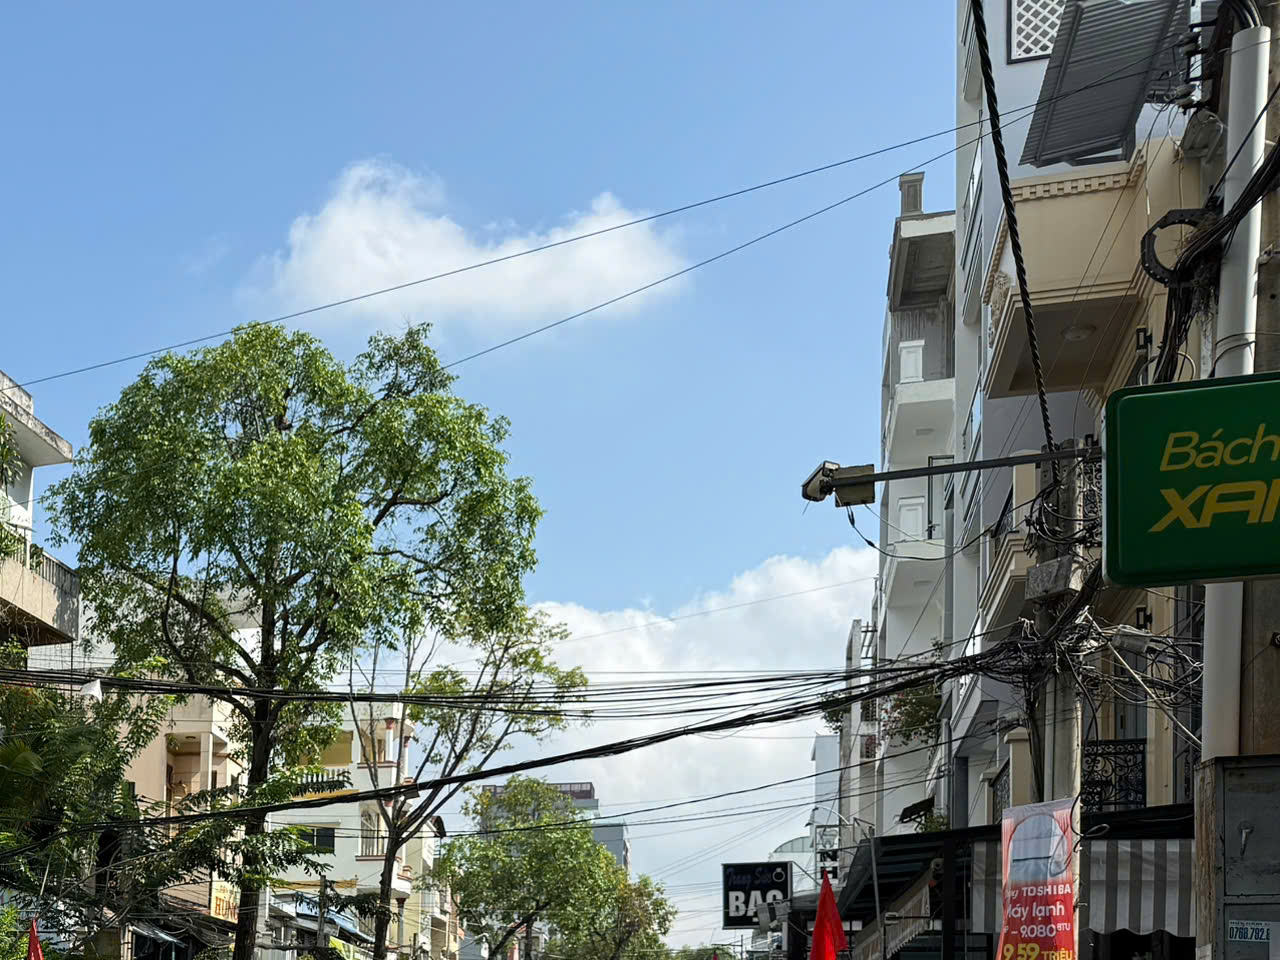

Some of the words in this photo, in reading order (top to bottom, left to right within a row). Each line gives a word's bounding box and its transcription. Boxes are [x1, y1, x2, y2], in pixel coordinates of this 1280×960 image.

[1159, 423, 1280, 472] Bách
[1022, 884, 1071, 897] TOSHIBA
[1032, 900, 1065, 920] lạnh
